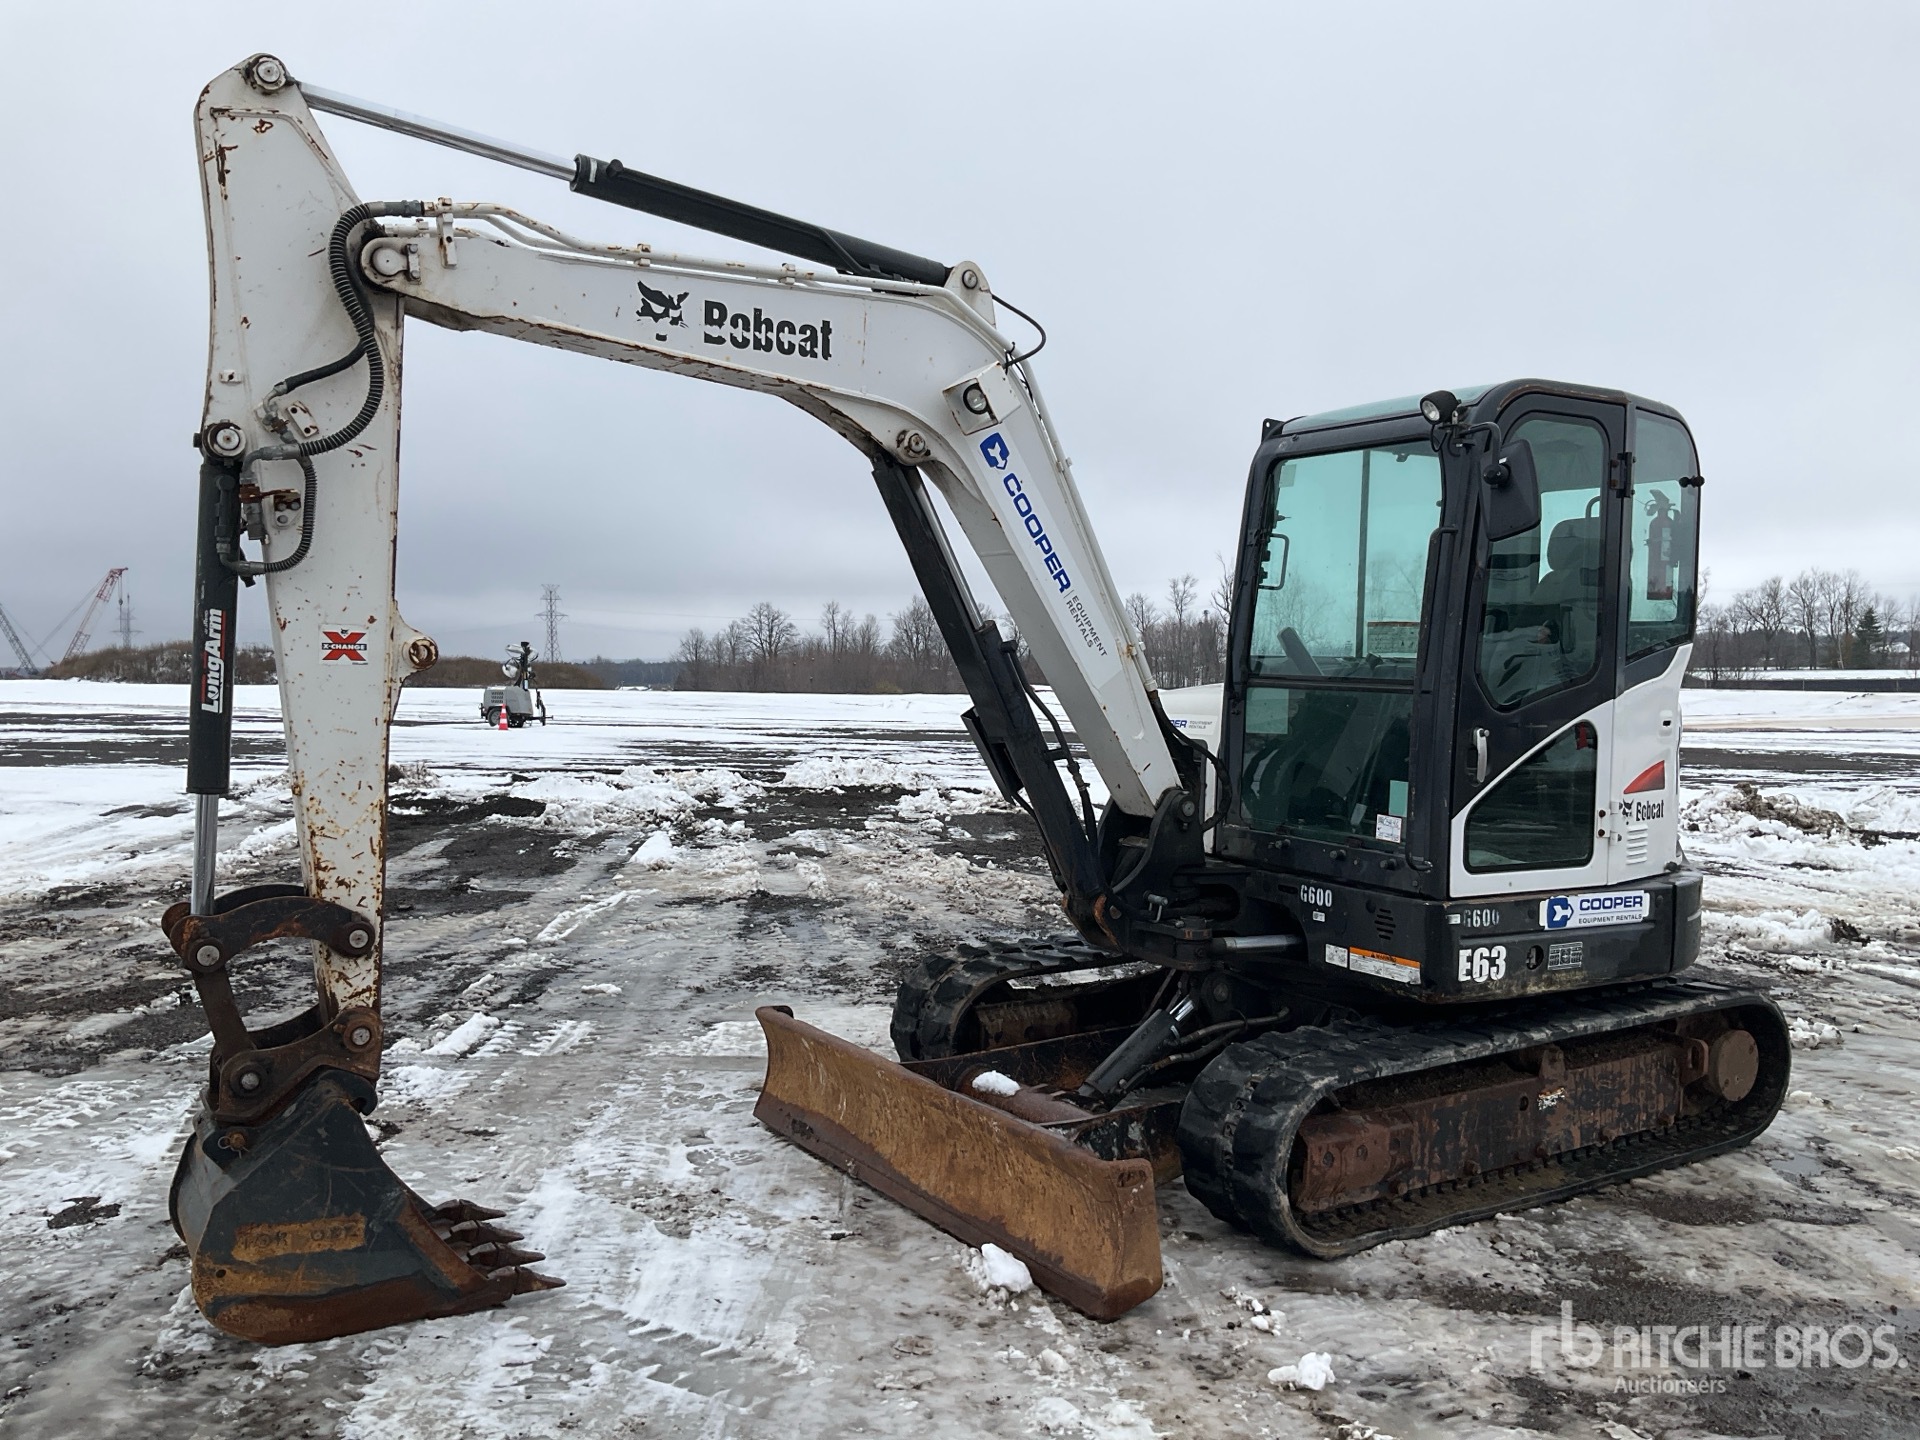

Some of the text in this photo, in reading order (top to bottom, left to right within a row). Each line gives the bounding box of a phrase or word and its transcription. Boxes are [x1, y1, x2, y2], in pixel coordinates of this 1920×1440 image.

[704, 300, 832, 361] Bobcat
[1003, 472, 1072, 593] COOPER
[1066, 600, 1094, 648] RENTALS
[1072, 595, 1107, 657] EQUIPMENT
[201, 608, 224, 714] LongArm
[1635, 799, 1664, 822] Bobcat
[1300, 884, 1333, 907] G600
[1579, 895, 1643, 911] COOPER
[1463, 908, 1500, 927] G600
[1578, 913, 1643, 924] EQUIPMENT RENTALS
[1458, 945, 1507, 983] E63
